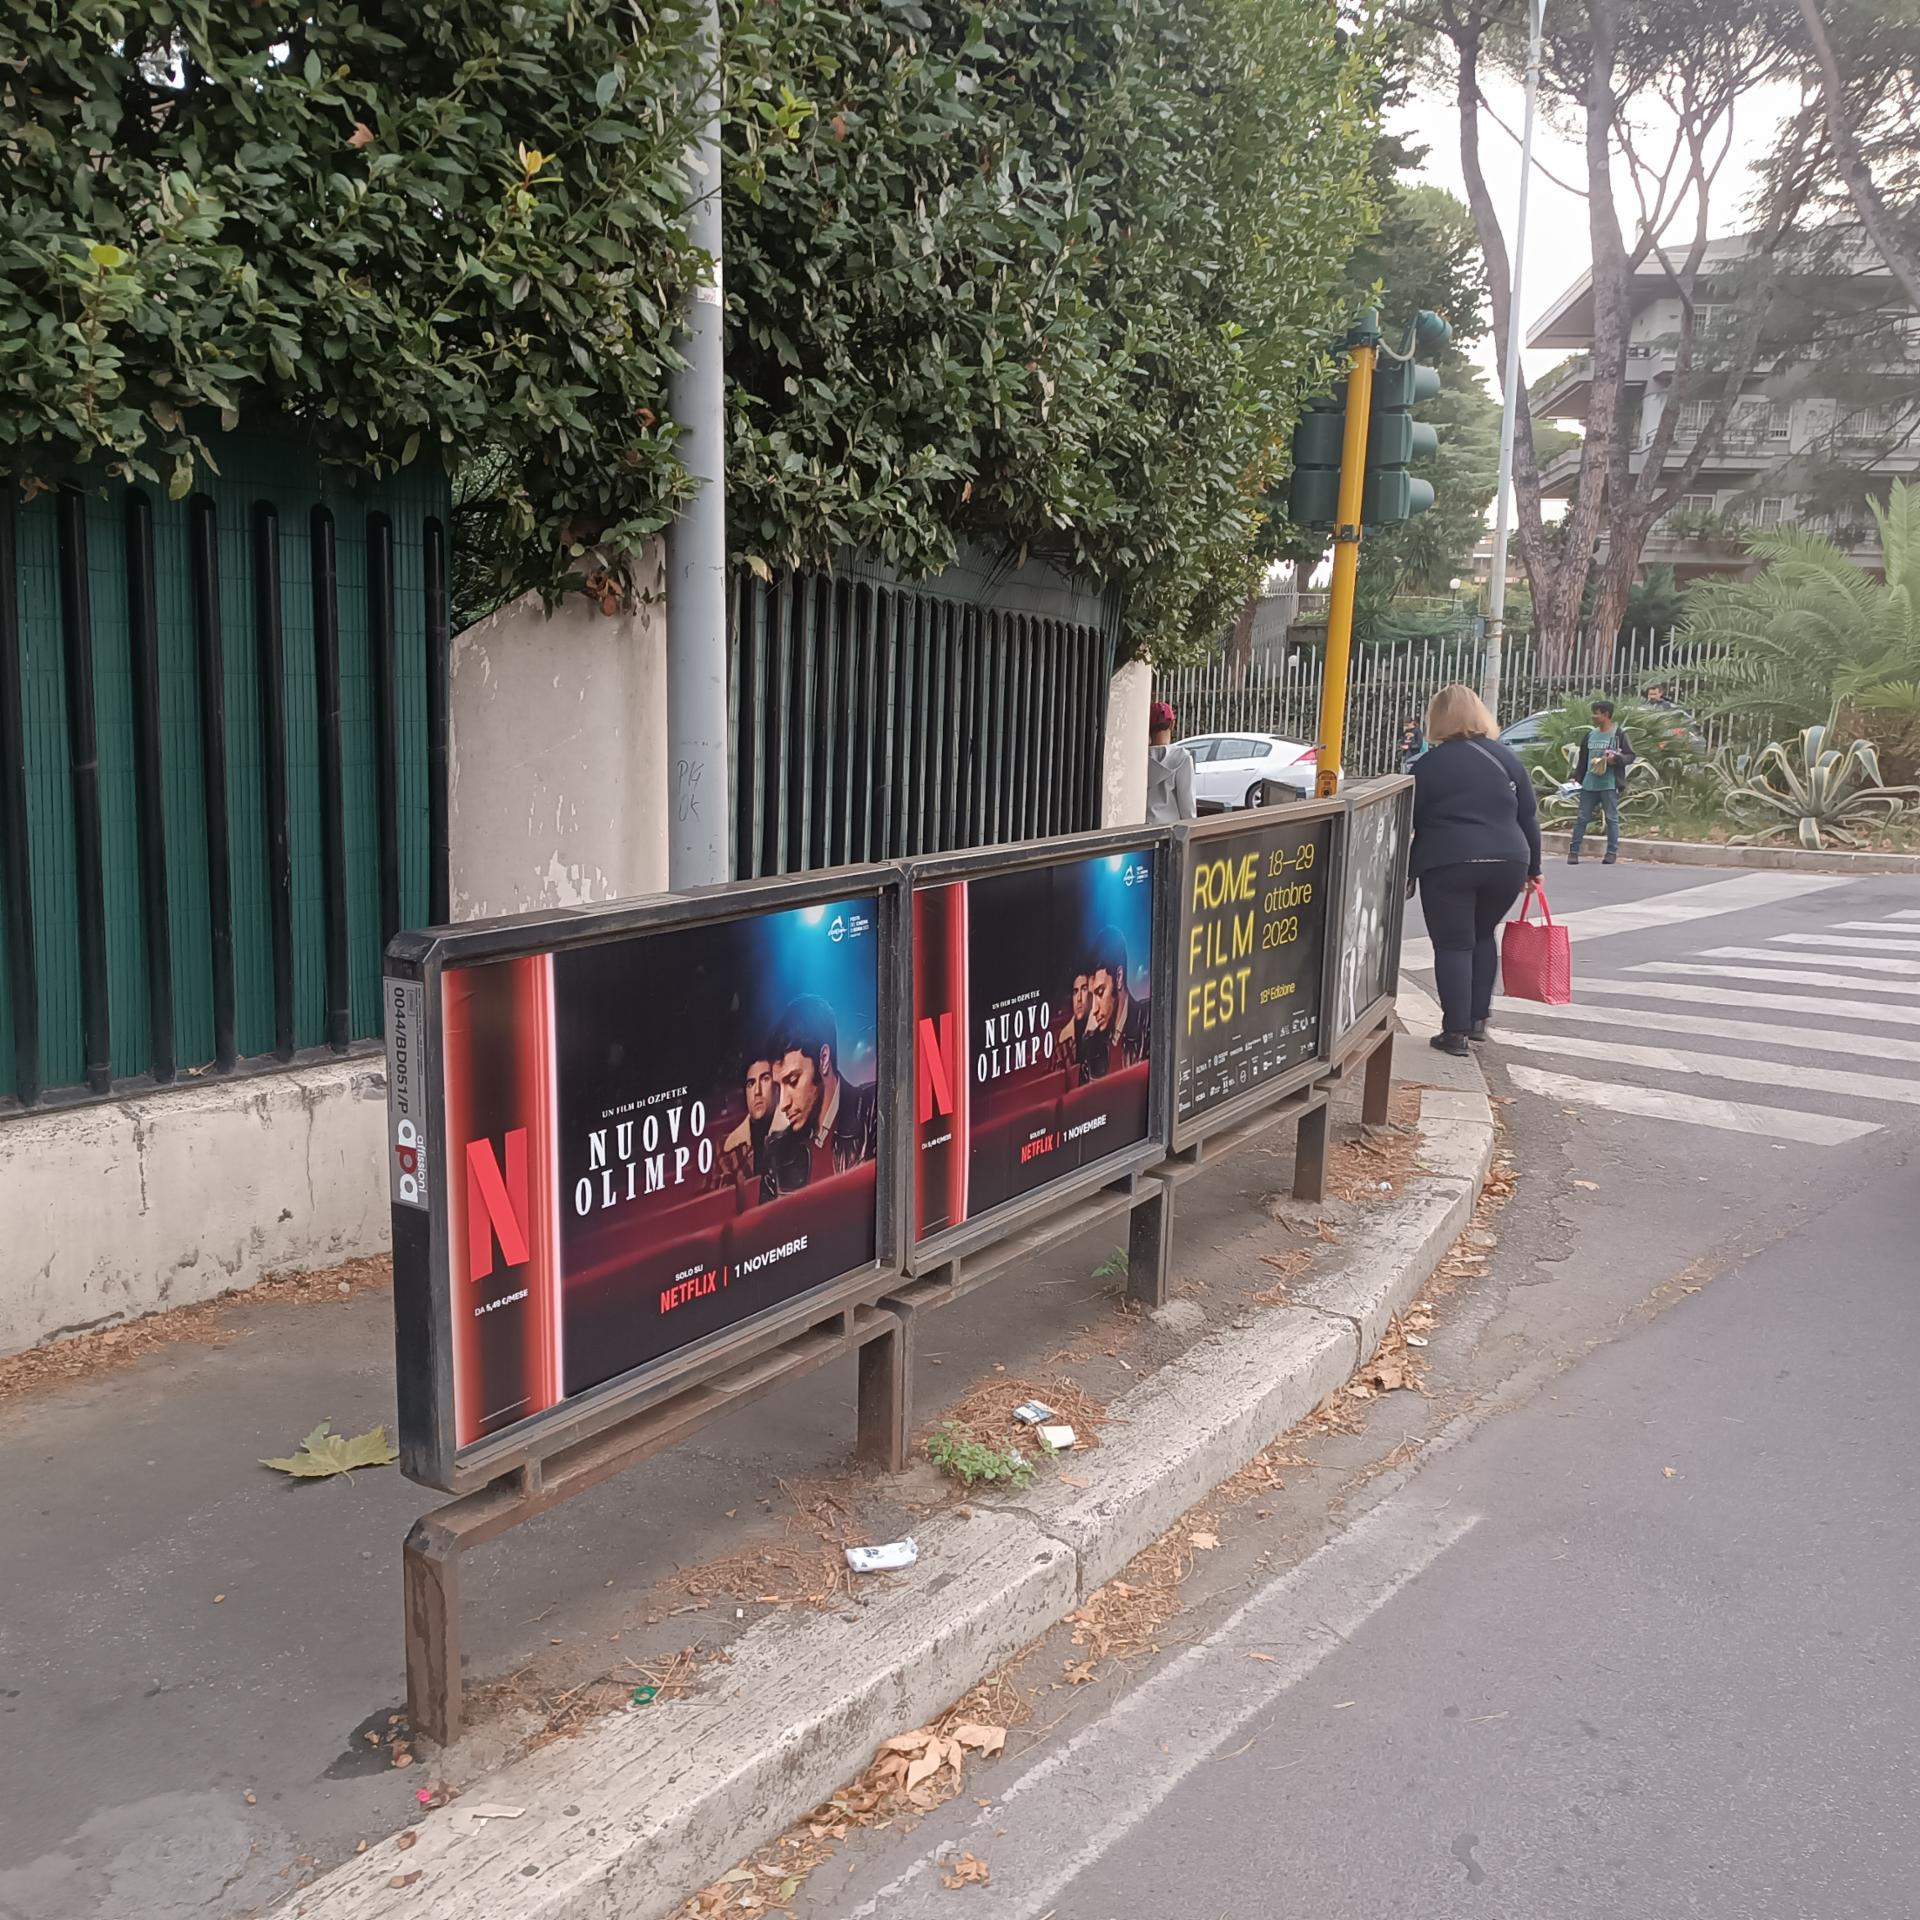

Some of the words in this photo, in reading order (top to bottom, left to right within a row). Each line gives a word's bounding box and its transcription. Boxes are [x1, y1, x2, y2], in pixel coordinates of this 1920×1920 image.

[1192, 851, 1260, 914] ROME
[1264, 881, 1313, 914] ottobre
[1189, 909, 1255, 976] FILM
[1262, 916, 1298, 950] 2023
[985, 1001, 1050, 1049] NUOVO
[1187, 966, 1252, 1037] FEST
[393, 986, 409, 1115] 0044/BD051/P
[919, 1011, 954, 1125] N
[977, 1030, 1054, 1083] OLIMPO
[601, 1107, 615, 1119] UN
[616, 1101, 635, 1115] FILM
[636, 1098, 647, 1110] DI
[647, 1085, 689, 1106] OZPETEK
[395, 1118, 419, 1203] apa
[588, 1100, 706, 1171] NUOVO
[1021, 1133, 1054, 1165] NETFLIX
[1068, 1114, 1107, 1141] NOVEMBRE
[466, 1127, 530, 1283] N
[575, 1138, 713, 1216] OLIMPO
[660, 1270, 717, 1315] NETFLIX
[734, 1264, 741, 1279] 1
[743, 1235, 808, 1276] NOVEMBRE
[675, 1268, 694, 1282] SOLO
[694, 1263, 704, 1274] SU
[474, 1306, 485, 1317] DA
